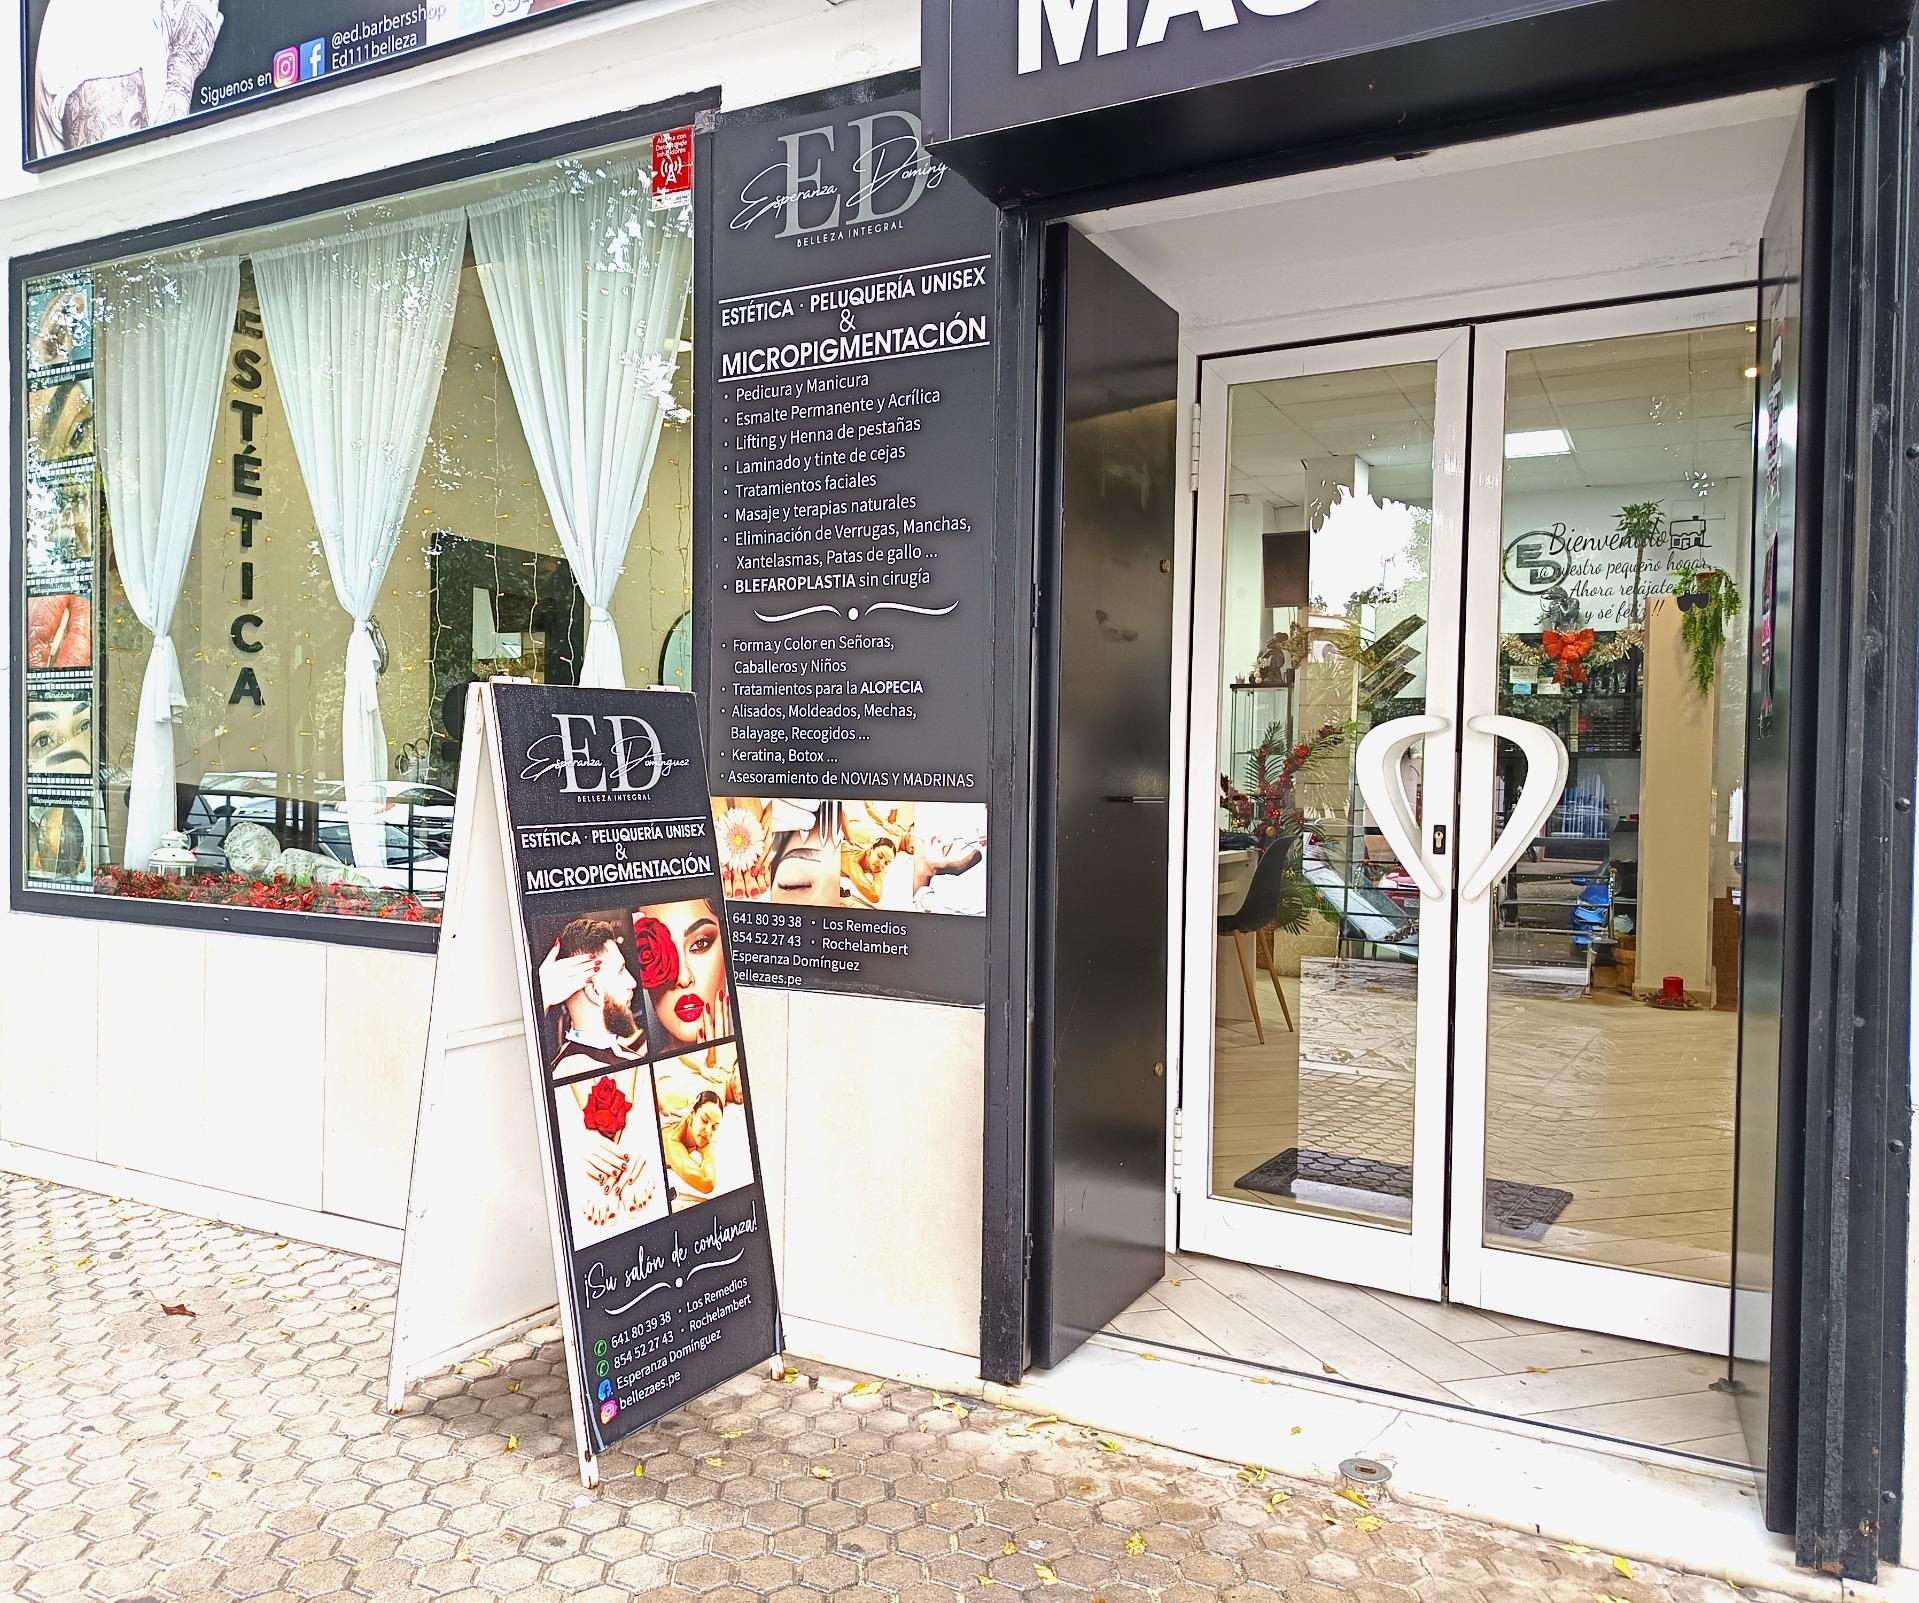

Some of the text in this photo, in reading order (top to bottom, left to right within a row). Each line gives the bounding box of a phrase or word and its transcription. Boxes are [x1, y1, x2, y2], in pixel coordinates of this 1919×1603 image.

[331, 4, 447, 49] @ed.barbersshop
[200, 72, 272, 107] Siguenos en
[775, 110, 931, 239] ED
[730, 162, 838, 230] Esperanza
[796, 220, 904, 248] BELLEZA INTEGRAL
[721, 266, 987, 327] ESTÉTICA PELUQUERÍA UNISEX
[839, 308, 857, 332] &
[721, 312, 987, 377] MICROPIGMENTACIÓN
[736, 373, 869, 402] Pedicura y Manicura
[736, 388, 940, 426] Esmalte Permanente y Acrílica
[736, 416, 921, 450] Lifting y Henna de pestañas
[736, 444, 905, 474] Laminado y tinte de cejas
[735, 472, 877, 498] Tratamientos faciales
[229, 308, 266, 706] ESTÉTICA
[735, 494, 916, 523] Masaje y terapias naturales
[735, 515, 971, 546] Eliminación de Verrugas, Manchas,
[736, 550, 823, 570] Xantelasmas,
[826, 548, 863, 565] Patas
[866, 545, 884, 562] de
[887, 544, 921, 566] gallo
[735, 568, 930, 594] BLEFAROPLASTIA sin cirugía
[1569, 580, 1614, 600] Ahora
[1585, 610, 1593, 624] y
[1597, 600, 1613, 618] sé
[733, 633, 894, 653] Forma y Color en Señoras,
[734, 658, 847, 675] Caballeros y Niños
[733, 680, 923, 699] Tratamientos para la ALOPECIA
[732, 702, 917, 720] Alisados, Moldeados, Mechas,
[731, 726, 789, 742] Balayage,
[791, 726, 856, 743] Recogidos
[521, 734, 602, 782] Esperanza
[552, 713, 662, 793] ED
[732, 748, 786, 764] Keratina,
[788, 748, 824, 763] Botox
[728, 770, 974, 788] Asesoramiento de NOVIAS Y MADRINAS
[577, 793, 652, 803] BELLEZA INTEGRAL
[521, 823, 706, 849] ESTÉTICA PELUQUERÍA UNISEX
[615, 843, 628, 860] &
[526, 852, 711, 890] MICROPIGMENTACIÓN
[732, 912, 907, 936] 641 80 39 38 Los Remedios
[732, 931, 909, 956] 854 52 27 43 Rochelambert
[732, 949, 859, 972] Esperanza Domínguez
[625, 1245, 664, 1287] salón
[671, 1231, 687, 1267] de
[694, 1200, 758, 1254] confianza!
[611, 1276, 748, 1349] 641 80 39 38 Los Remedios
[613, 1294, 752, 1369] 854 52 27 43 Rochelambert
[616, 1328, 722, 1390] Esperanza Domínguez
[619, 1370, 681, 1410] bellezaes.pe
